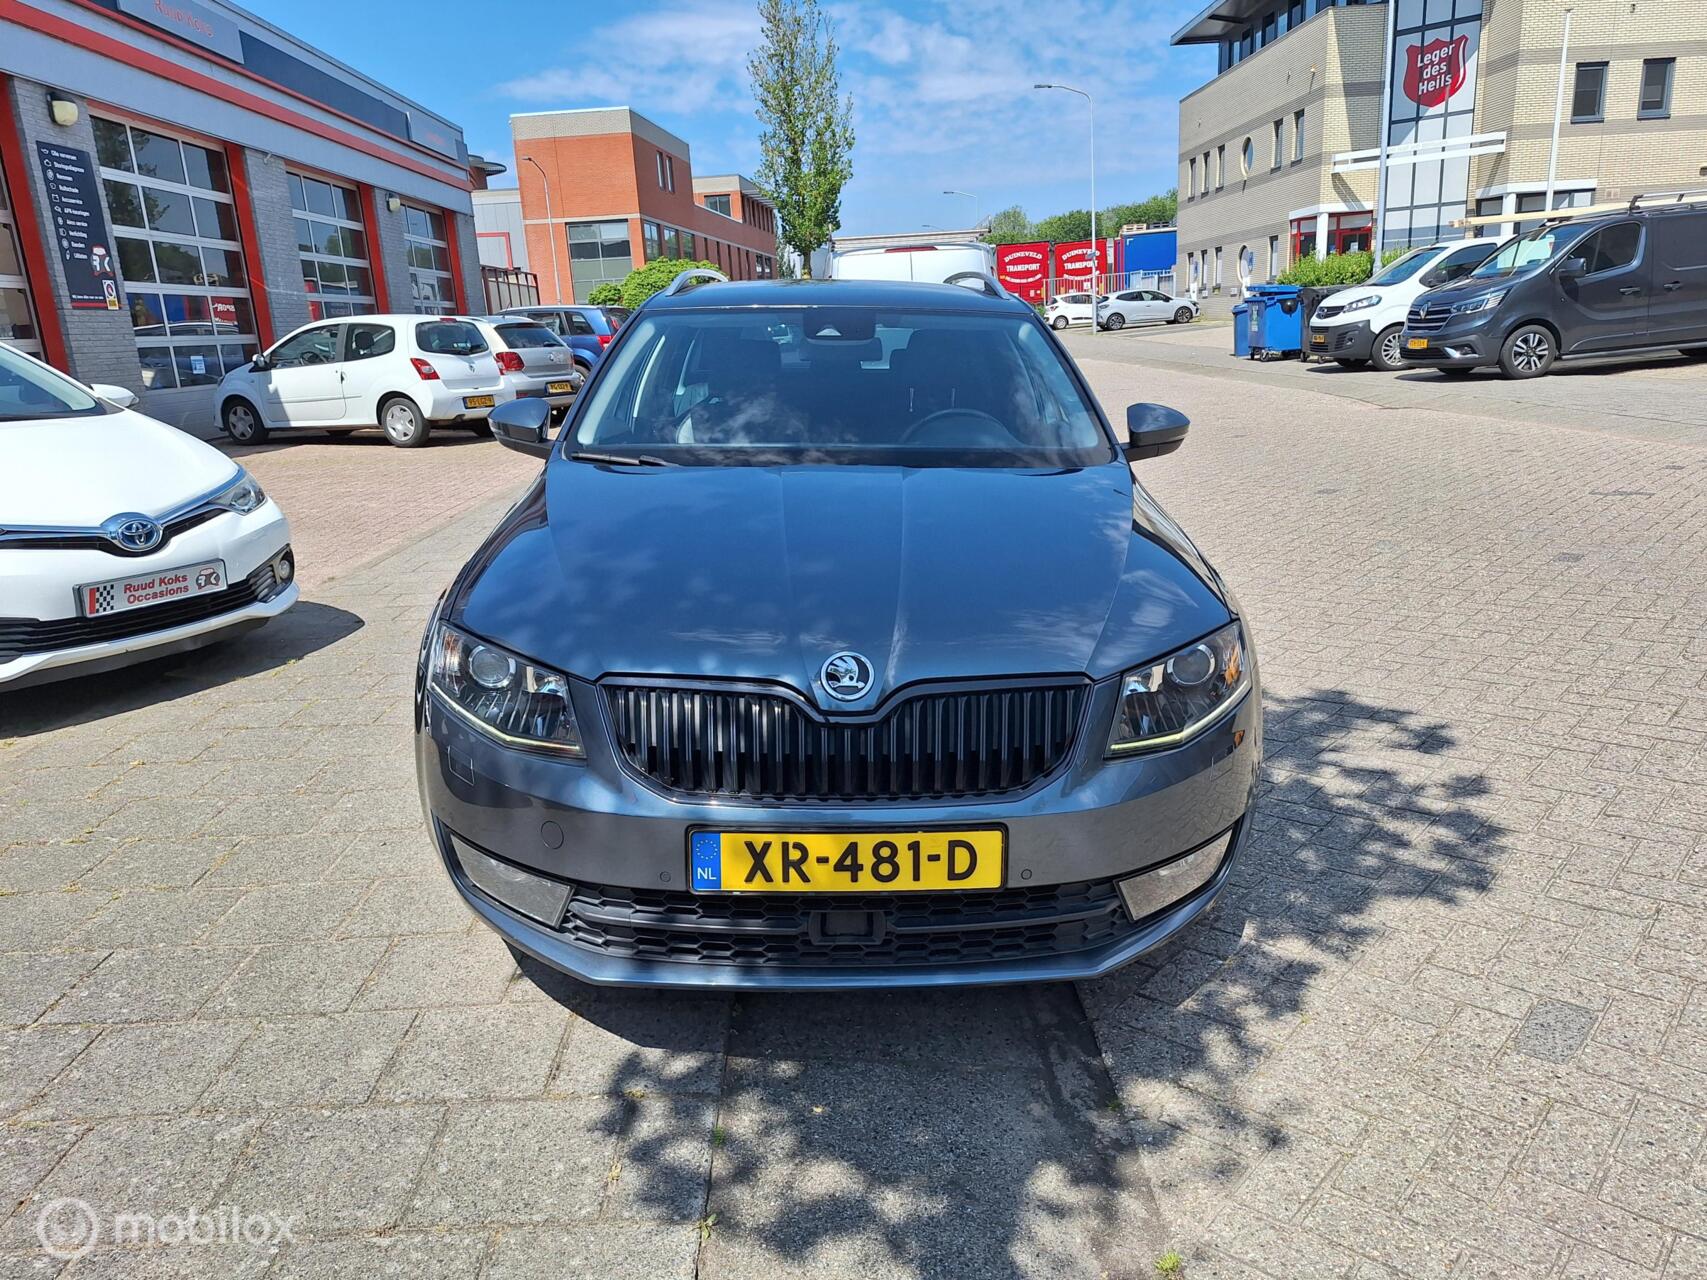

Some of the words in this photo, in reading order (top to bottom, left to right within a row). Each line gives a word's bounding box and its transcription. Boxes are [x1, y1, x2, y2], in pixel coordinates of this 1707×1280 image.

[1417, 43, 1456, 68] Leger
[1423, 61, 1447, 79] des
[1418, 74, 1452, 96] Heils
[1004, 251, 1043, 263] DUINEVELD
[1006, 263, 1041, 272] TRANSPORT
[123, 579, 155, 594] Ruud
[158, 573, 188, 587] Koks
[127, 585, 190, 605] Occasions
[743, 840, 978, 884] XR-481-D
[697, 867, 716, 881] NL
